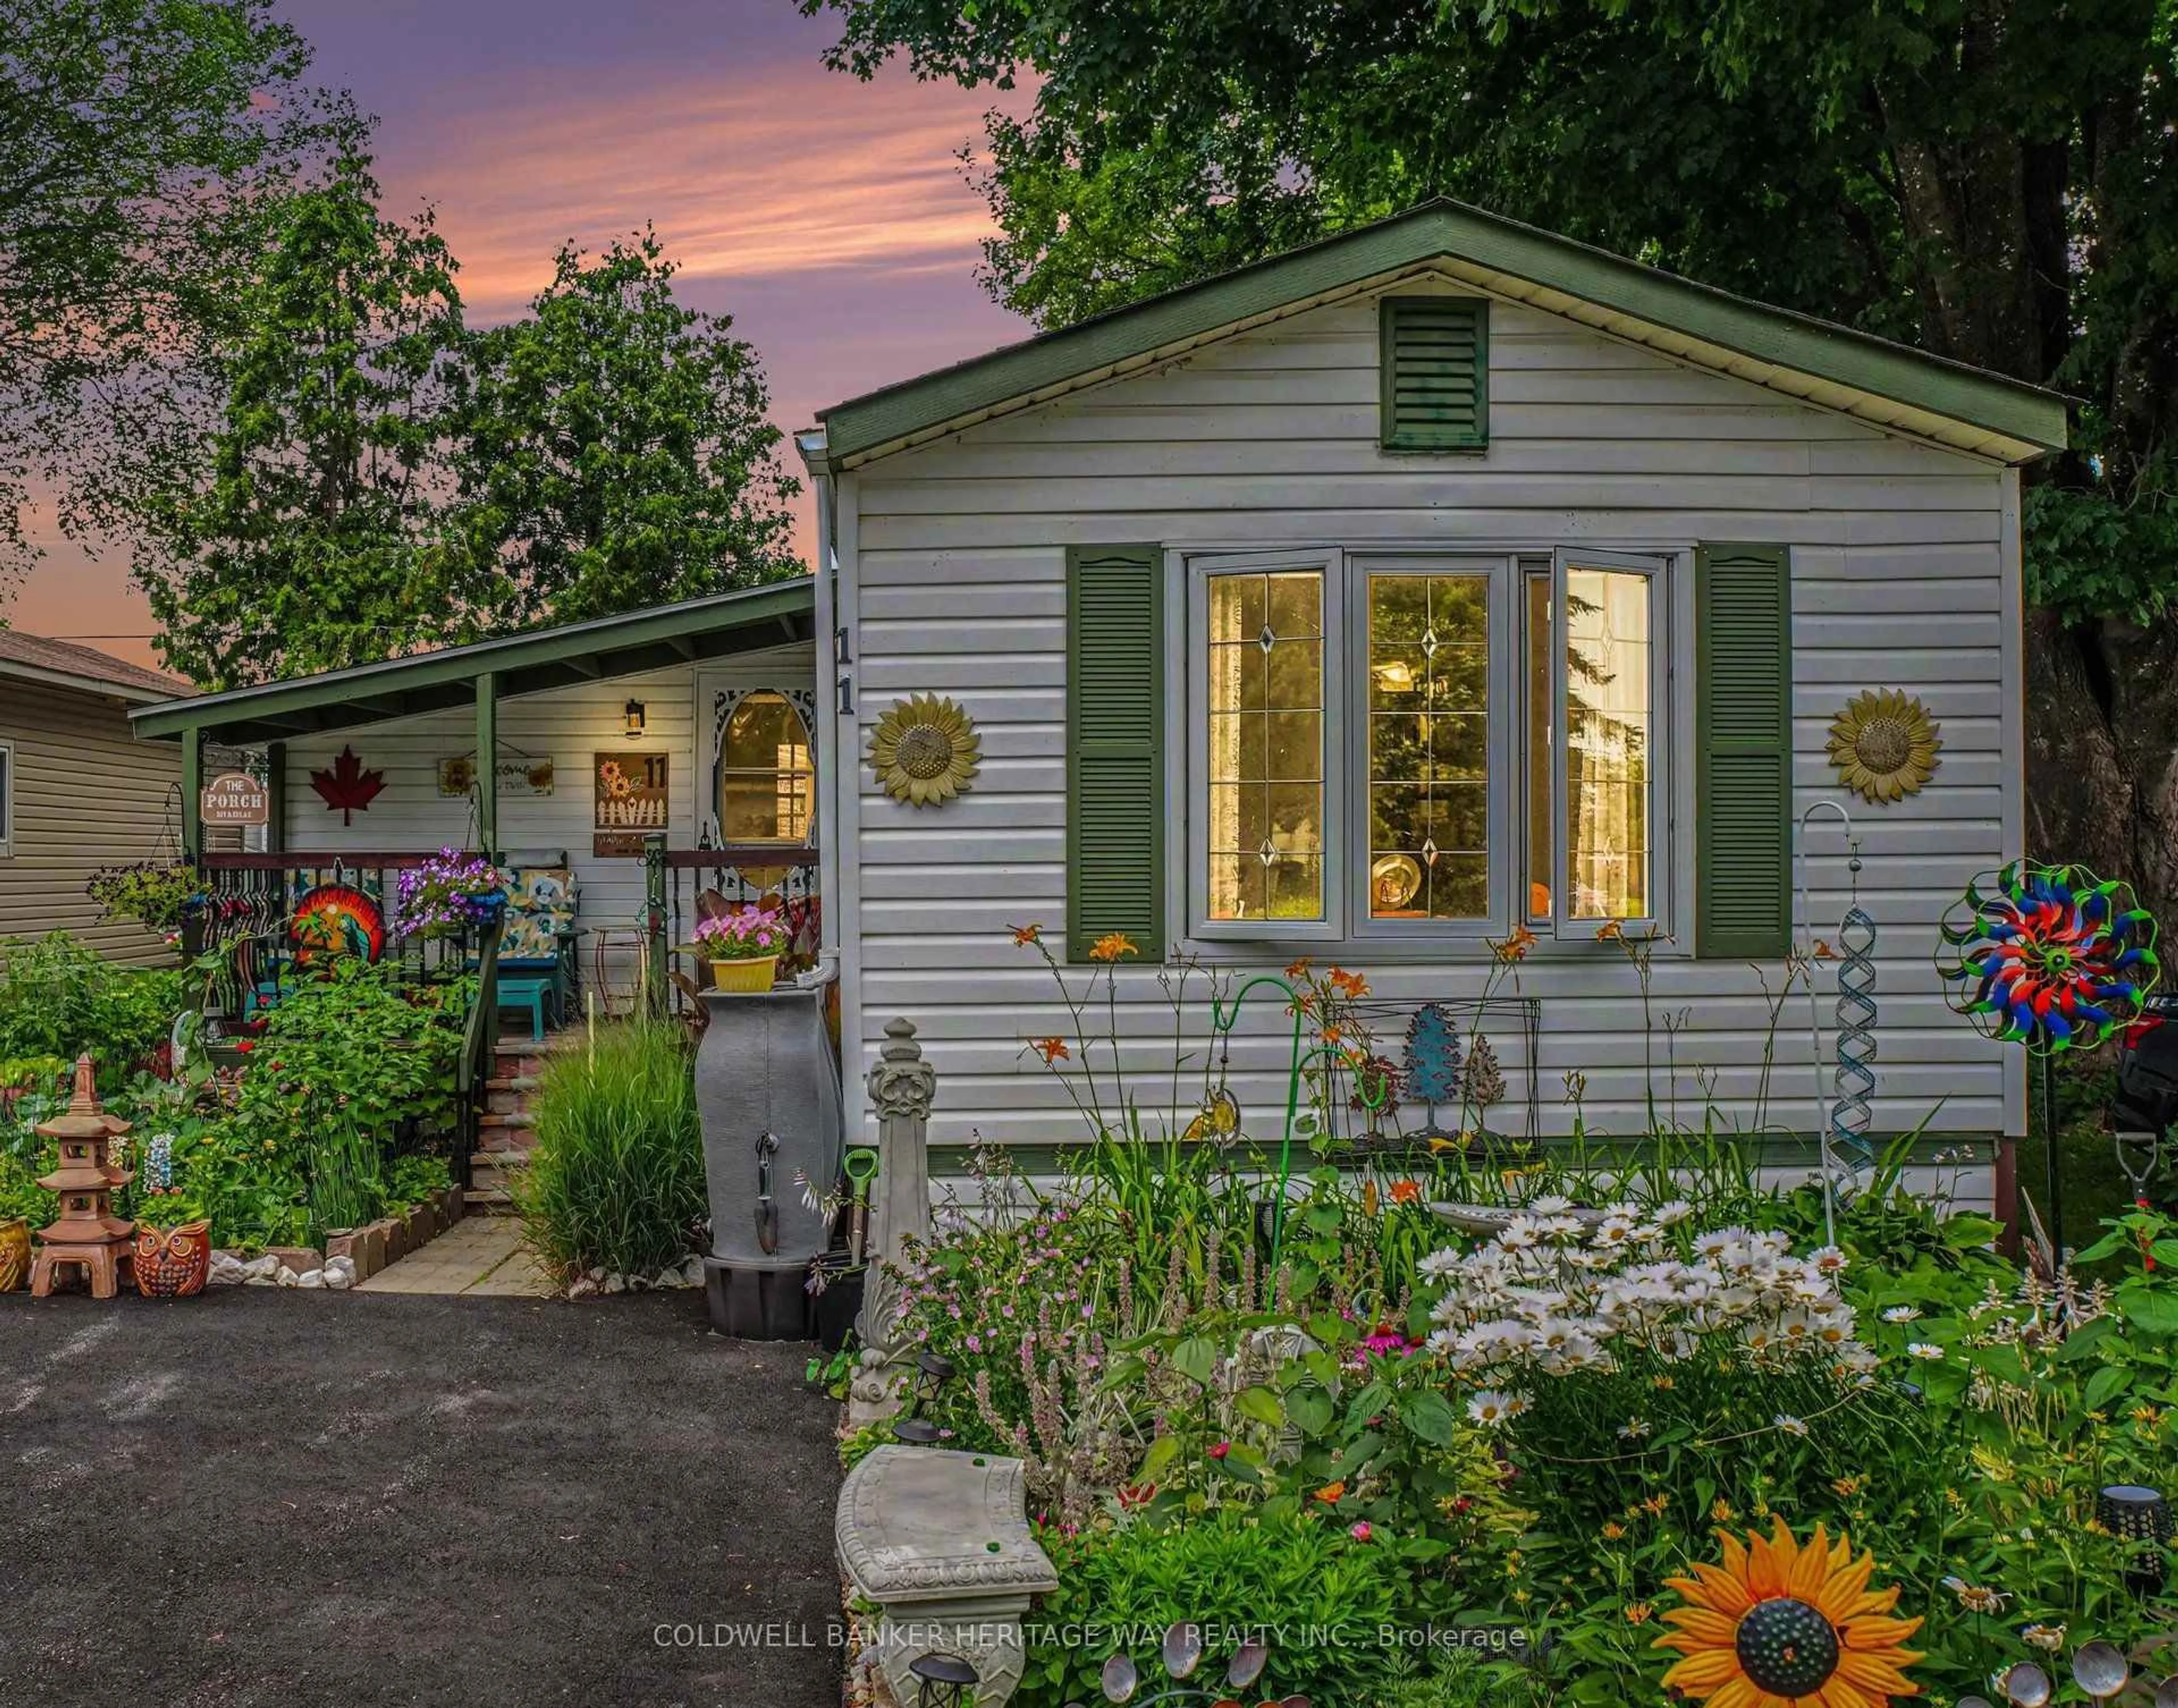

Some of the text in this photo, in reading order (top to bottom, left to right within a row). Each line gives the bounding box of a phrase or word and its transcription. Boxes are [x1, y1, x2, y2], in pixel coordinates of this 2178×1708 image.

[644, 757, 665, 788] 11
[225, 780, 244, 791] THE
[206, 794, 262, 808] PORCH
